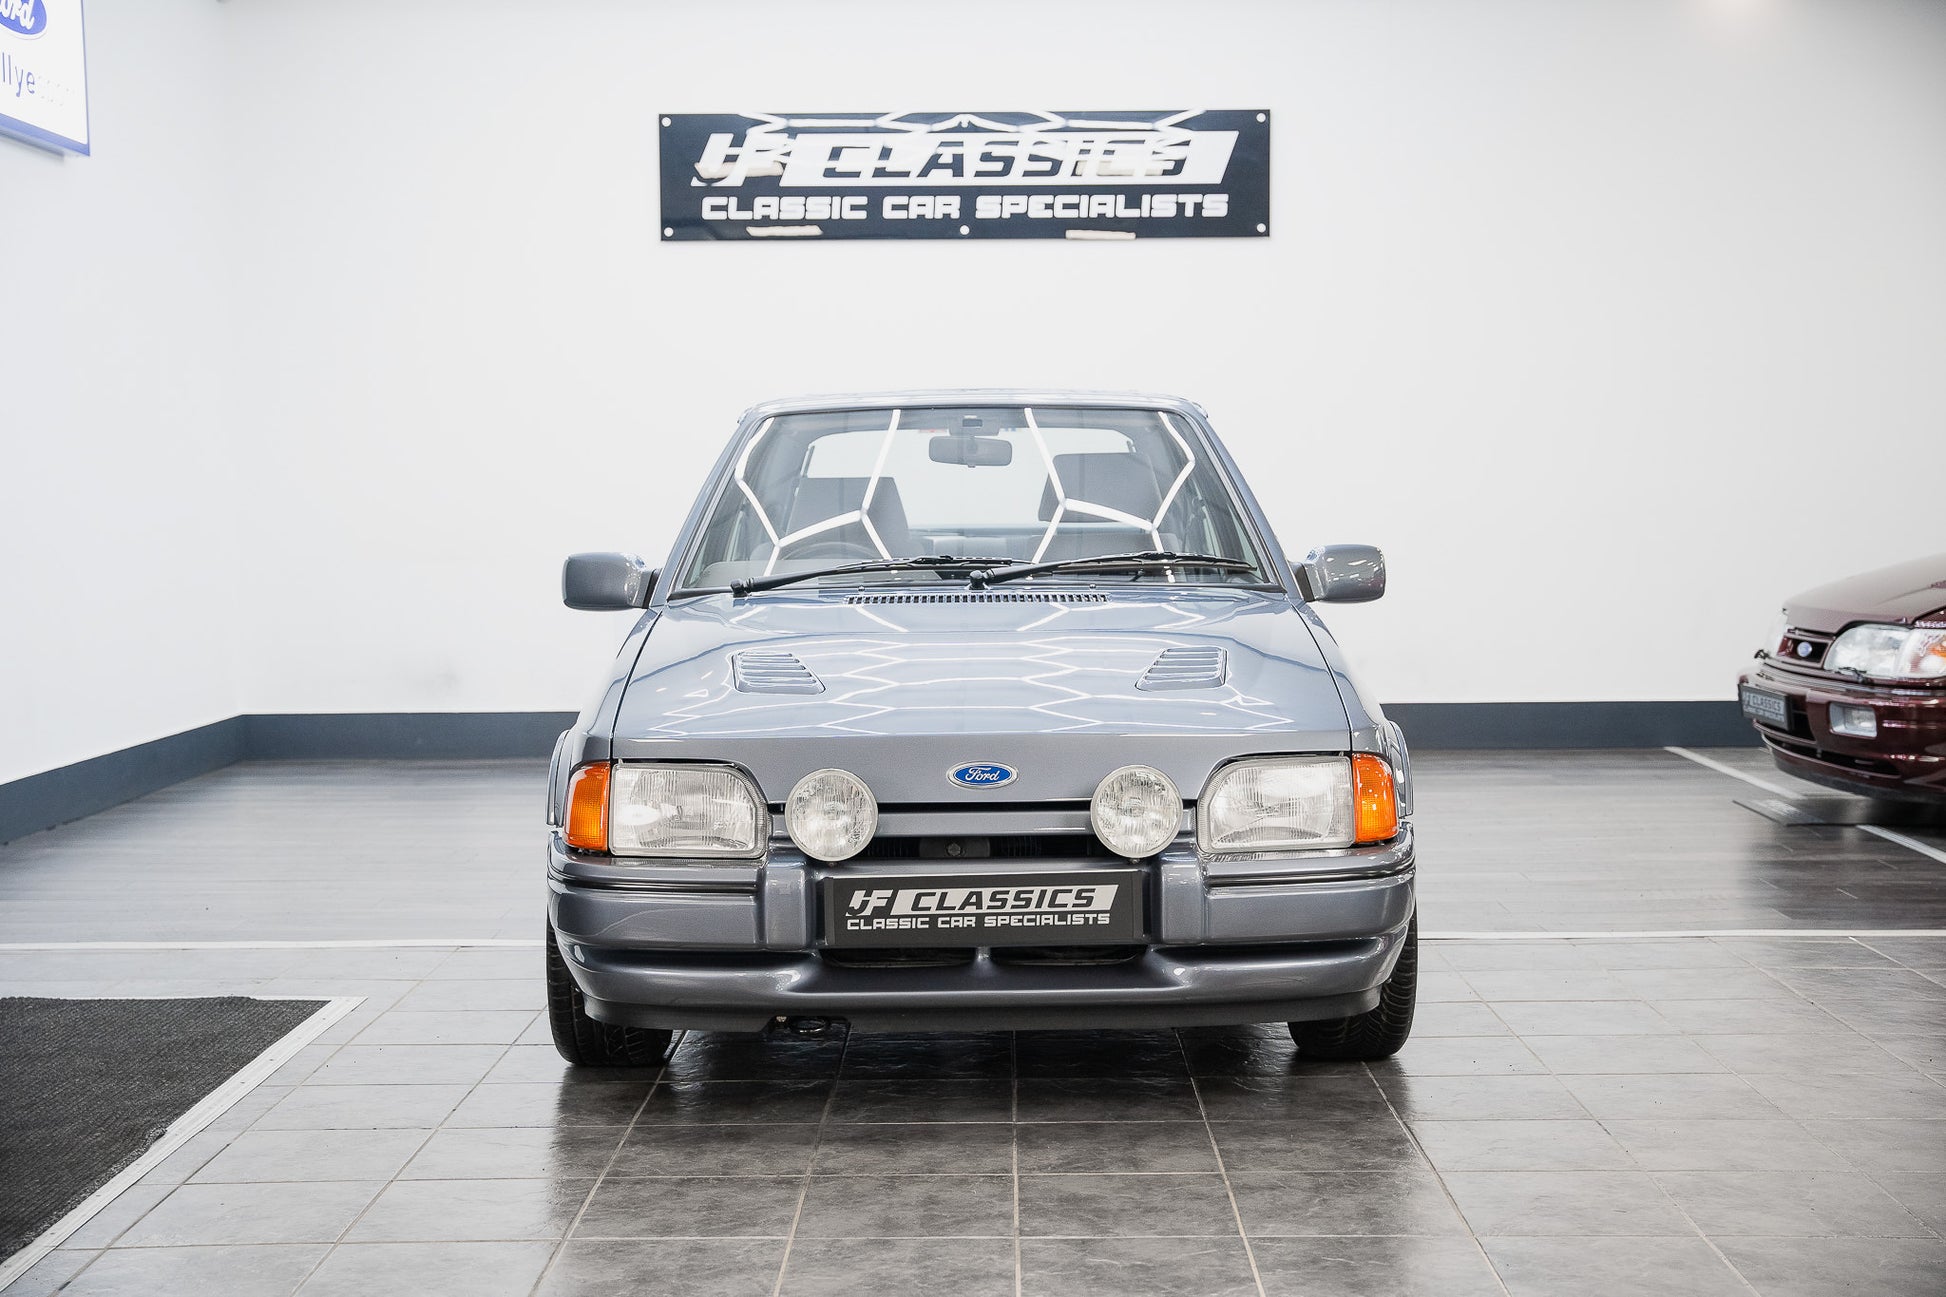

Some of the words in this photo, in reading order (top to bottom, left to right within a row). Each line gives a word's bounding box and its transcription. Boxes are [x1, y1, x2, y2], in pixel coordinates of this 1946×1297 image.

[0, 0, 35, 29] ord
[822, 139, 1192, 178] CLASSICS
[701, 196, 868, 220] CLASSIC
[882, 195, 960, 220] CAR
[975, 193, 1229, 219] SPECIALISTS
[965, 766, 1001, 782] Ford
[845, 889, 894, 917] JF
[911, 888, 1096, 911] CLASSICS
[846, 917, 930, 930] CLASSIC
[937, 915, 976, 929] CAR
[983, 912, 1111, 928] SPECIALISTS
